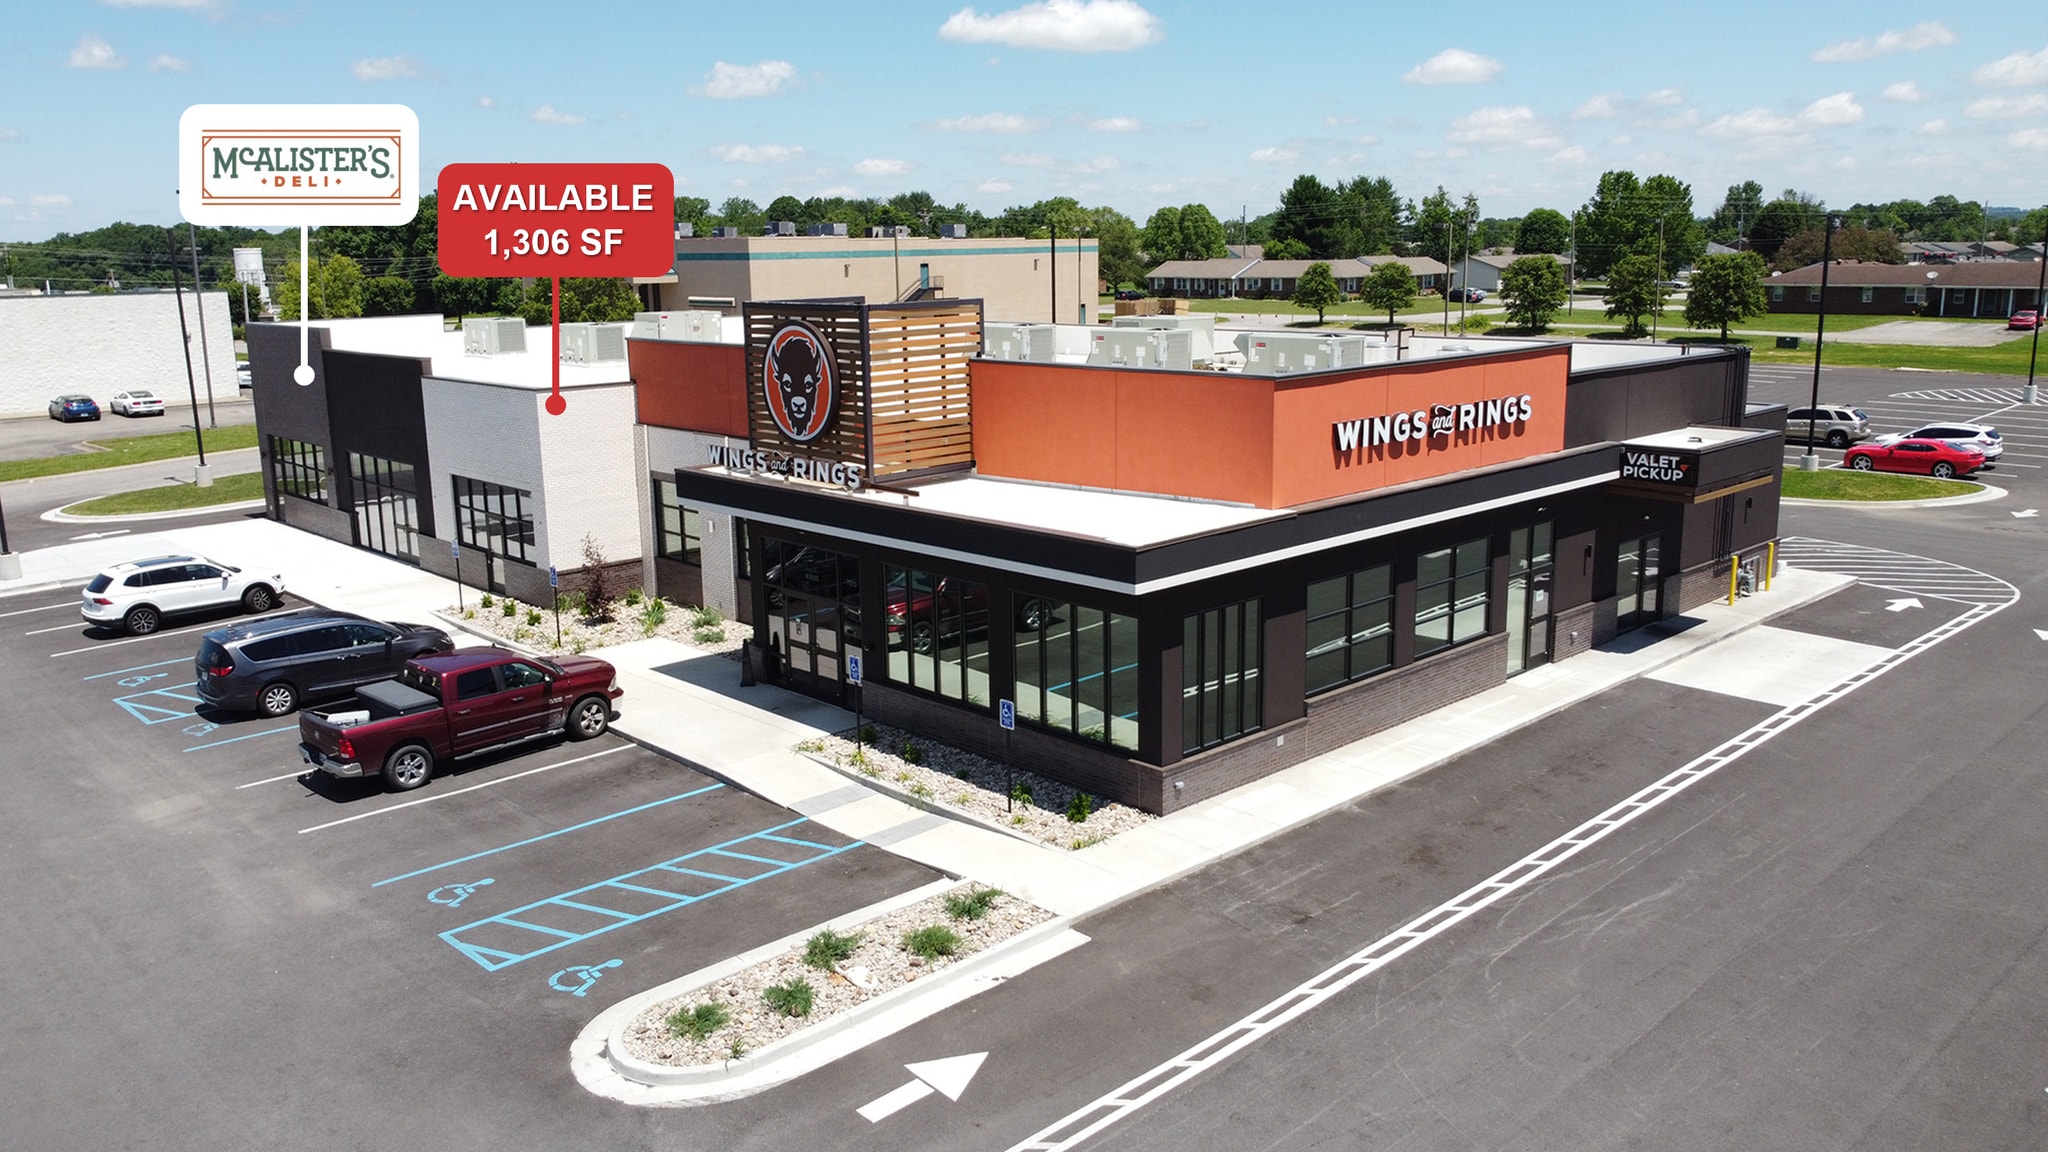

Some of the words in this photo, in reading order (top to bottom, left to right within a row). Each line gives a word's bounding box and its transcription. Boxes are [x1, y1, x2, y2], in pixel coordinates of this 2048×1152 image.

[1336, 410, 1427, 451] WINGS
[1431, 404, 1456, 438] and
[1459, 394, 1532, 431] RINGS
[708, 444, 767, 473] WINGS
[770, 450, 789, 476] and
[793, 457, 861, 488] RINGS
[1623, 465, 1683, 481] PICKUP
[1627, 452, 1680, 469] VALET
